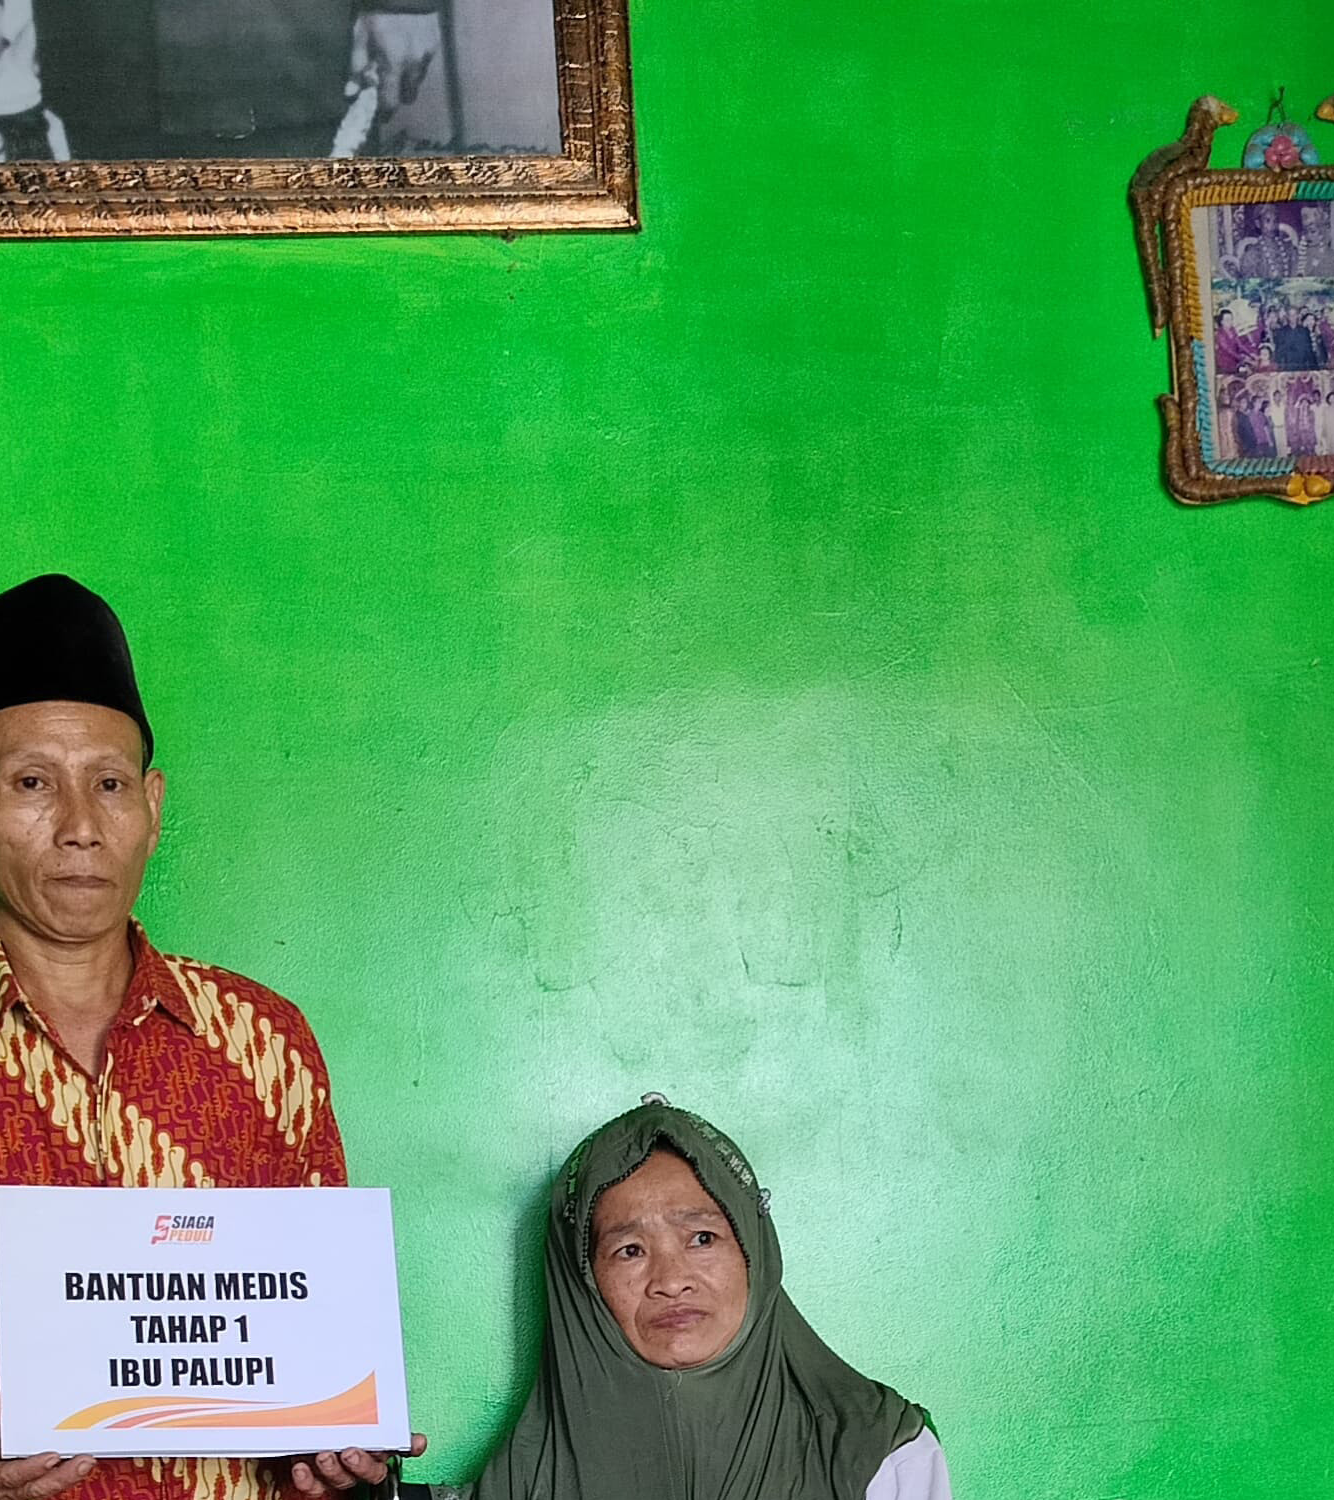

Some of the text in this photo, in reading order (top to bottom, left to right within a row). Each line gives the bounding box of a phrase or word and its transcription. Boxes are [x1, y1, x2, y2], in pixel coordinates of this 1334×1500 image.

[168, 1230, 215, 1243] PEDULI
[171, 1215, 215, 1230] SIAGA
[64, 1272, 309, 1301] BANTUAN MEDIS
[131, 1315, 249, 1344] TAHAP 1
[109, 1357, 275, 1387] IBU PALUPI
